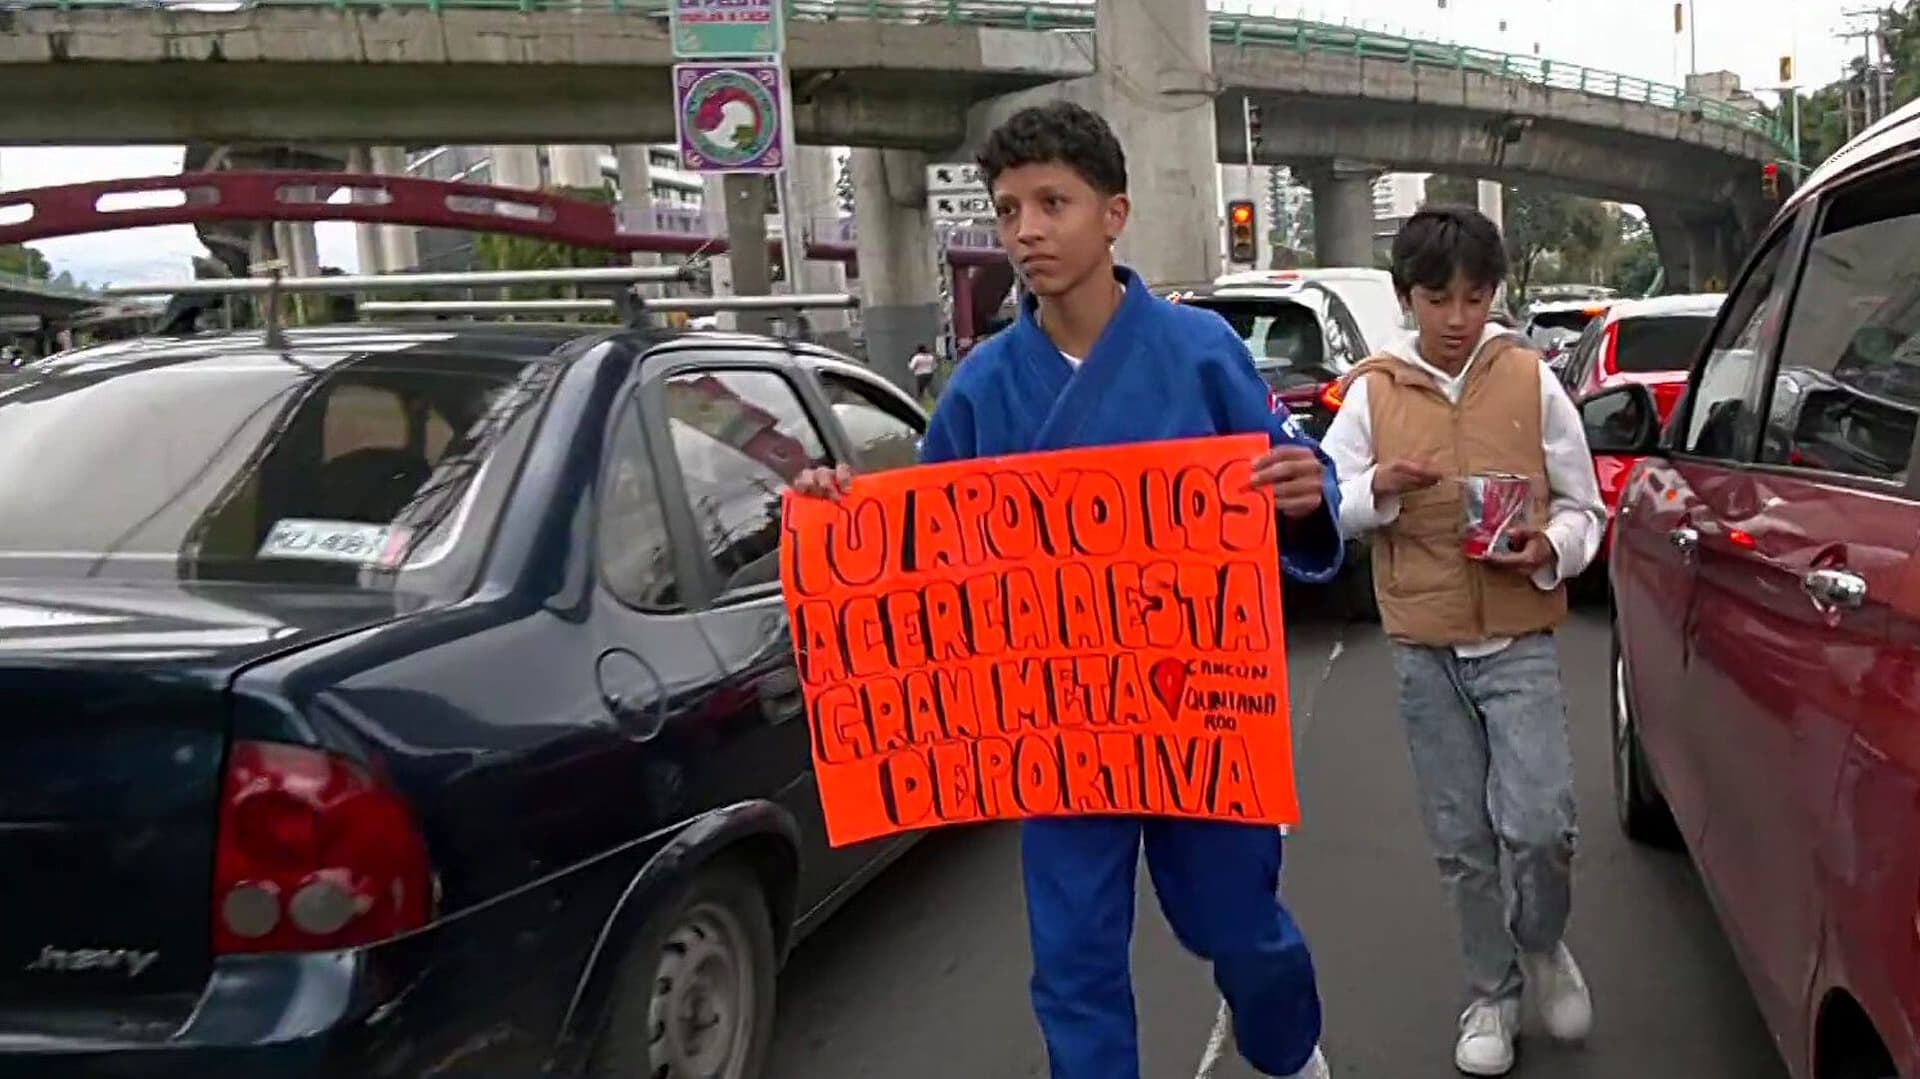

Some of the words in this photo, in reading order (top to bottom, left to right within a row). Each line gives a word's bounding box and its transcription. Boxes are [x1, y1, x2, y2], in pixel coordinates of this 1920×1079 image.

[785, 482, 888, 597] TU
[901, 470, 1127, 572] APOYO
[1139, 458, 1270, 553] LOS
[795, 566, 1050, 686] ACERCA
[1056, 561, 1104, 650] A
[1105, 559, 1271, 652] ESTA
[812, 665, 982, 765] GRAN
[990, 652, 1151, 734] META
[1204, 713, 1237, 732] ROO
[878, 729, 1265, 827] DEPORTIVA
